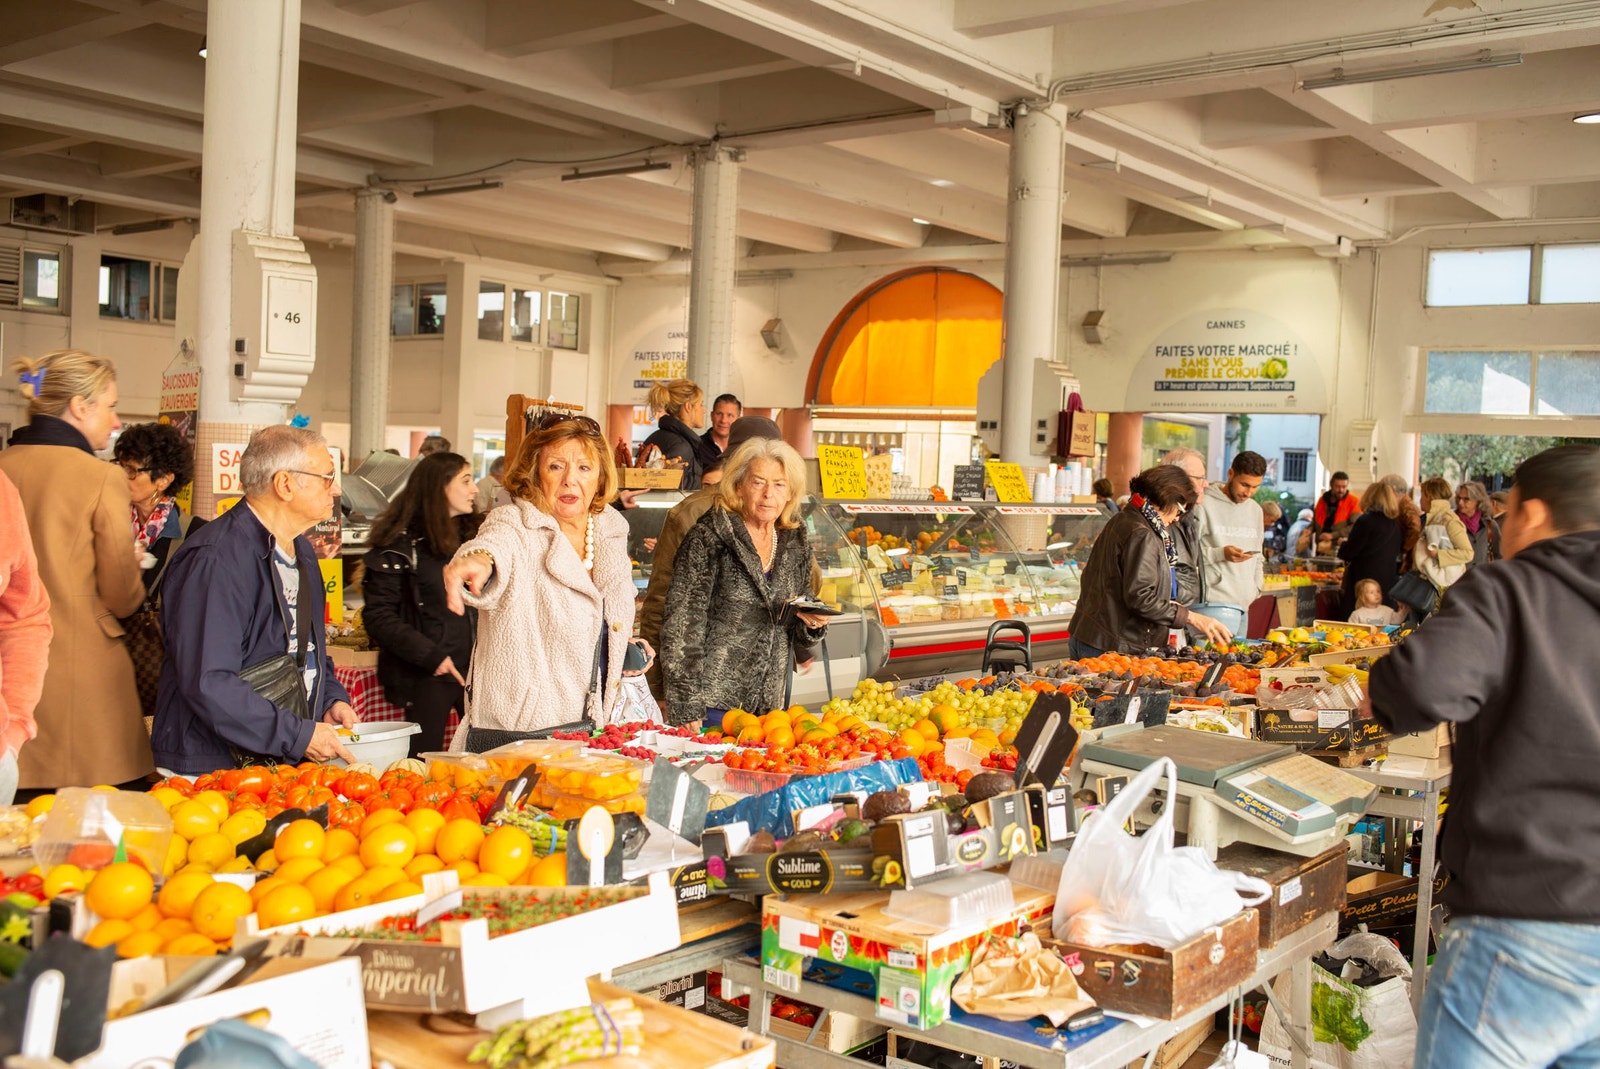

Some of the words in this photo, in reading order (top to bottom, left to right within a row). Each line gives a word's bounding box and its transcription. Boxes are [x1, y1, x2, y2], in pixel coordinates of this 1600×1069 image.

[285, 312, 300, 324] 46
[1206, 320, 1246, 329] CANNES
[634, 352, 660, 361] FAITES
[662, 351, 686, 360] VOTRE
[1155, 346, 1195, 357] FAITES
[1198, 345, 1235, 356] VOTRE
[1239, 341, 1291, 356] MARCHÉ
[1181, 357, 1209, 367] SANS
[1213, 357, 1243, 367] VOUS
[1165, 368, 1209, 378] PRENDRE
[1212, 369, 1223, 378] LE
[1226, 368, 1259, 378] CHOU
[162, 372, 199, 391] SAUCISSONS
[160, 393, 197, 410] D'AUVERGNE
[825, 448, 859, 459] EMMENTAL
[777, 858, 821, 875] Sublime
[680, 883, 707, 899] blime
[790, 879, 812, 889] GOLD
[1380, 893, 1418, 909] Plais
[1344, 902, 1377, 919] Petit
[363, 965, 450, 1000] mperial
[660, 974, 694, 1000] gliorini
[1266, 1053, 1292, 1067] carref
